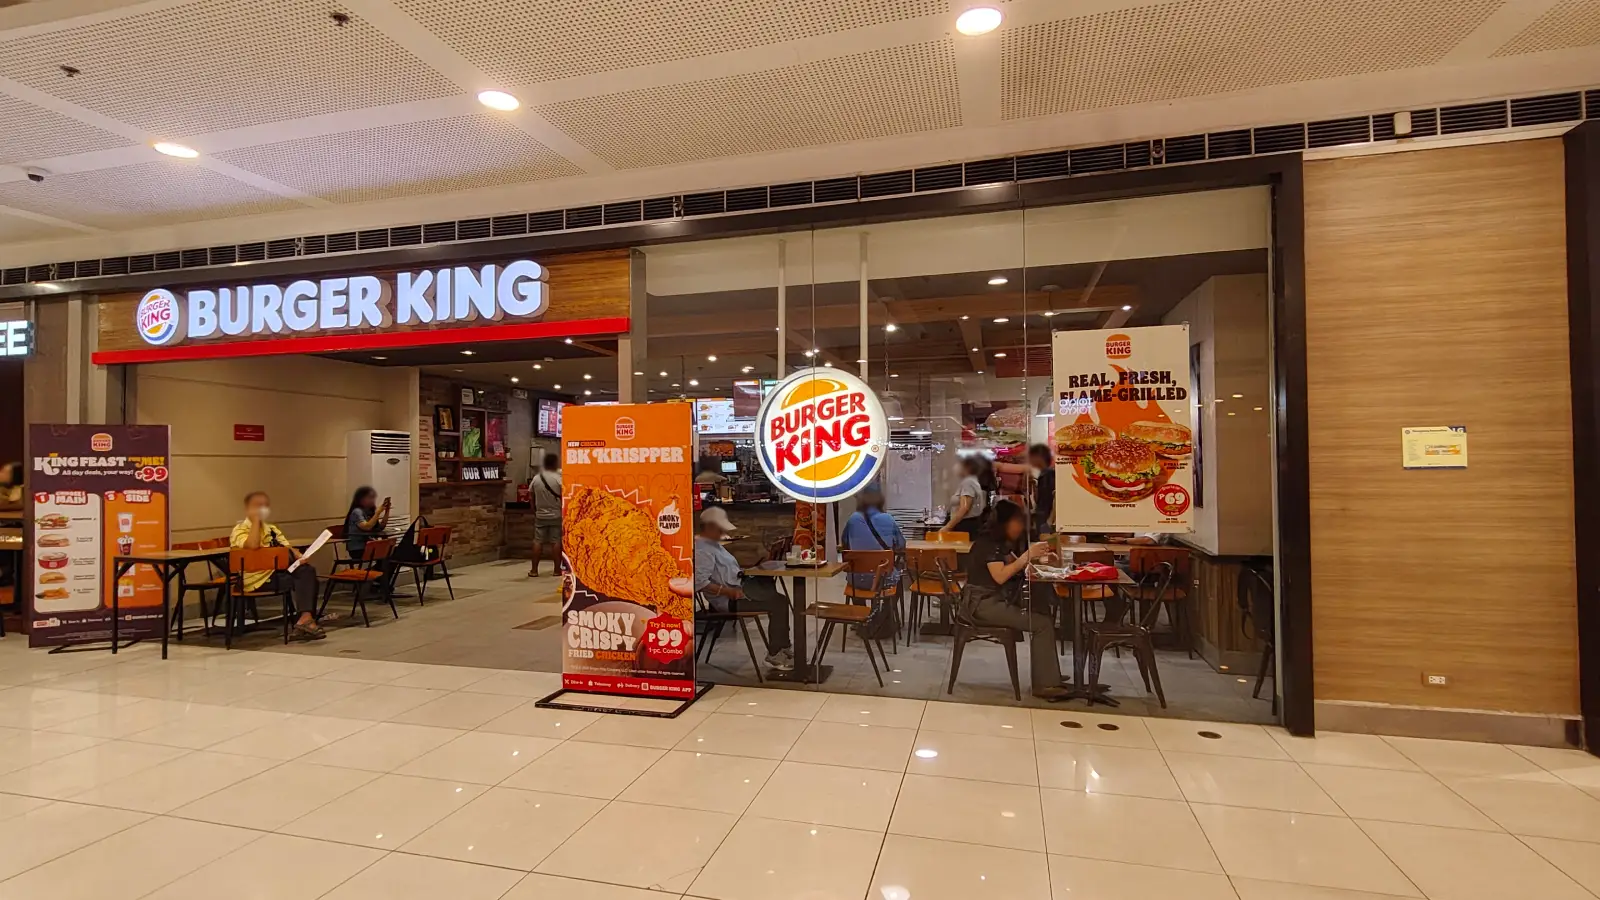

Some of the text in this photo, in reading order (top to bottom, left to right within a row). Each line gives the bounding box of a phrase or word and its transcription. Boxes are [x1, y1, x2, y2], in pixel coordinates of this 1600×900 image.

[188, 259, 542, 338] BURGER KING
[140, 299, 171, 317] BURGER
[140, 308, 171, 329] KING
[1106, 347, 1131, 355] KING
[1068, 371, 1177, 389] REAL, FRESH,
[1060, 387, 1187, 403] FLAME-GRILLED
[770, 392, 866, 442] BURGER
[775, 414, 871, 473] KING
[34, 453, 79, 475] KING
[80, 457, 127, 467] FEAST
[566, 449, 591, 464] BK
[462, 466, 499, 480] OUR WAY
[56, 496, 86, 504] MAIN
[126, 495, 150, 503] SIDE
[659, 514, 680, 522] SMOKY
[659, 521, 680, 530] FLAVOR
[567, 610, 636, 637] SMOKY
[649, 621, 661, 629] Try
[567, 624, 637, 652] CRISPY
[568, 649, 637, 661] FRIED CHICKEN
[663, 647, 683, 655] Combo
[649, 684, 669, 692] BURGER
